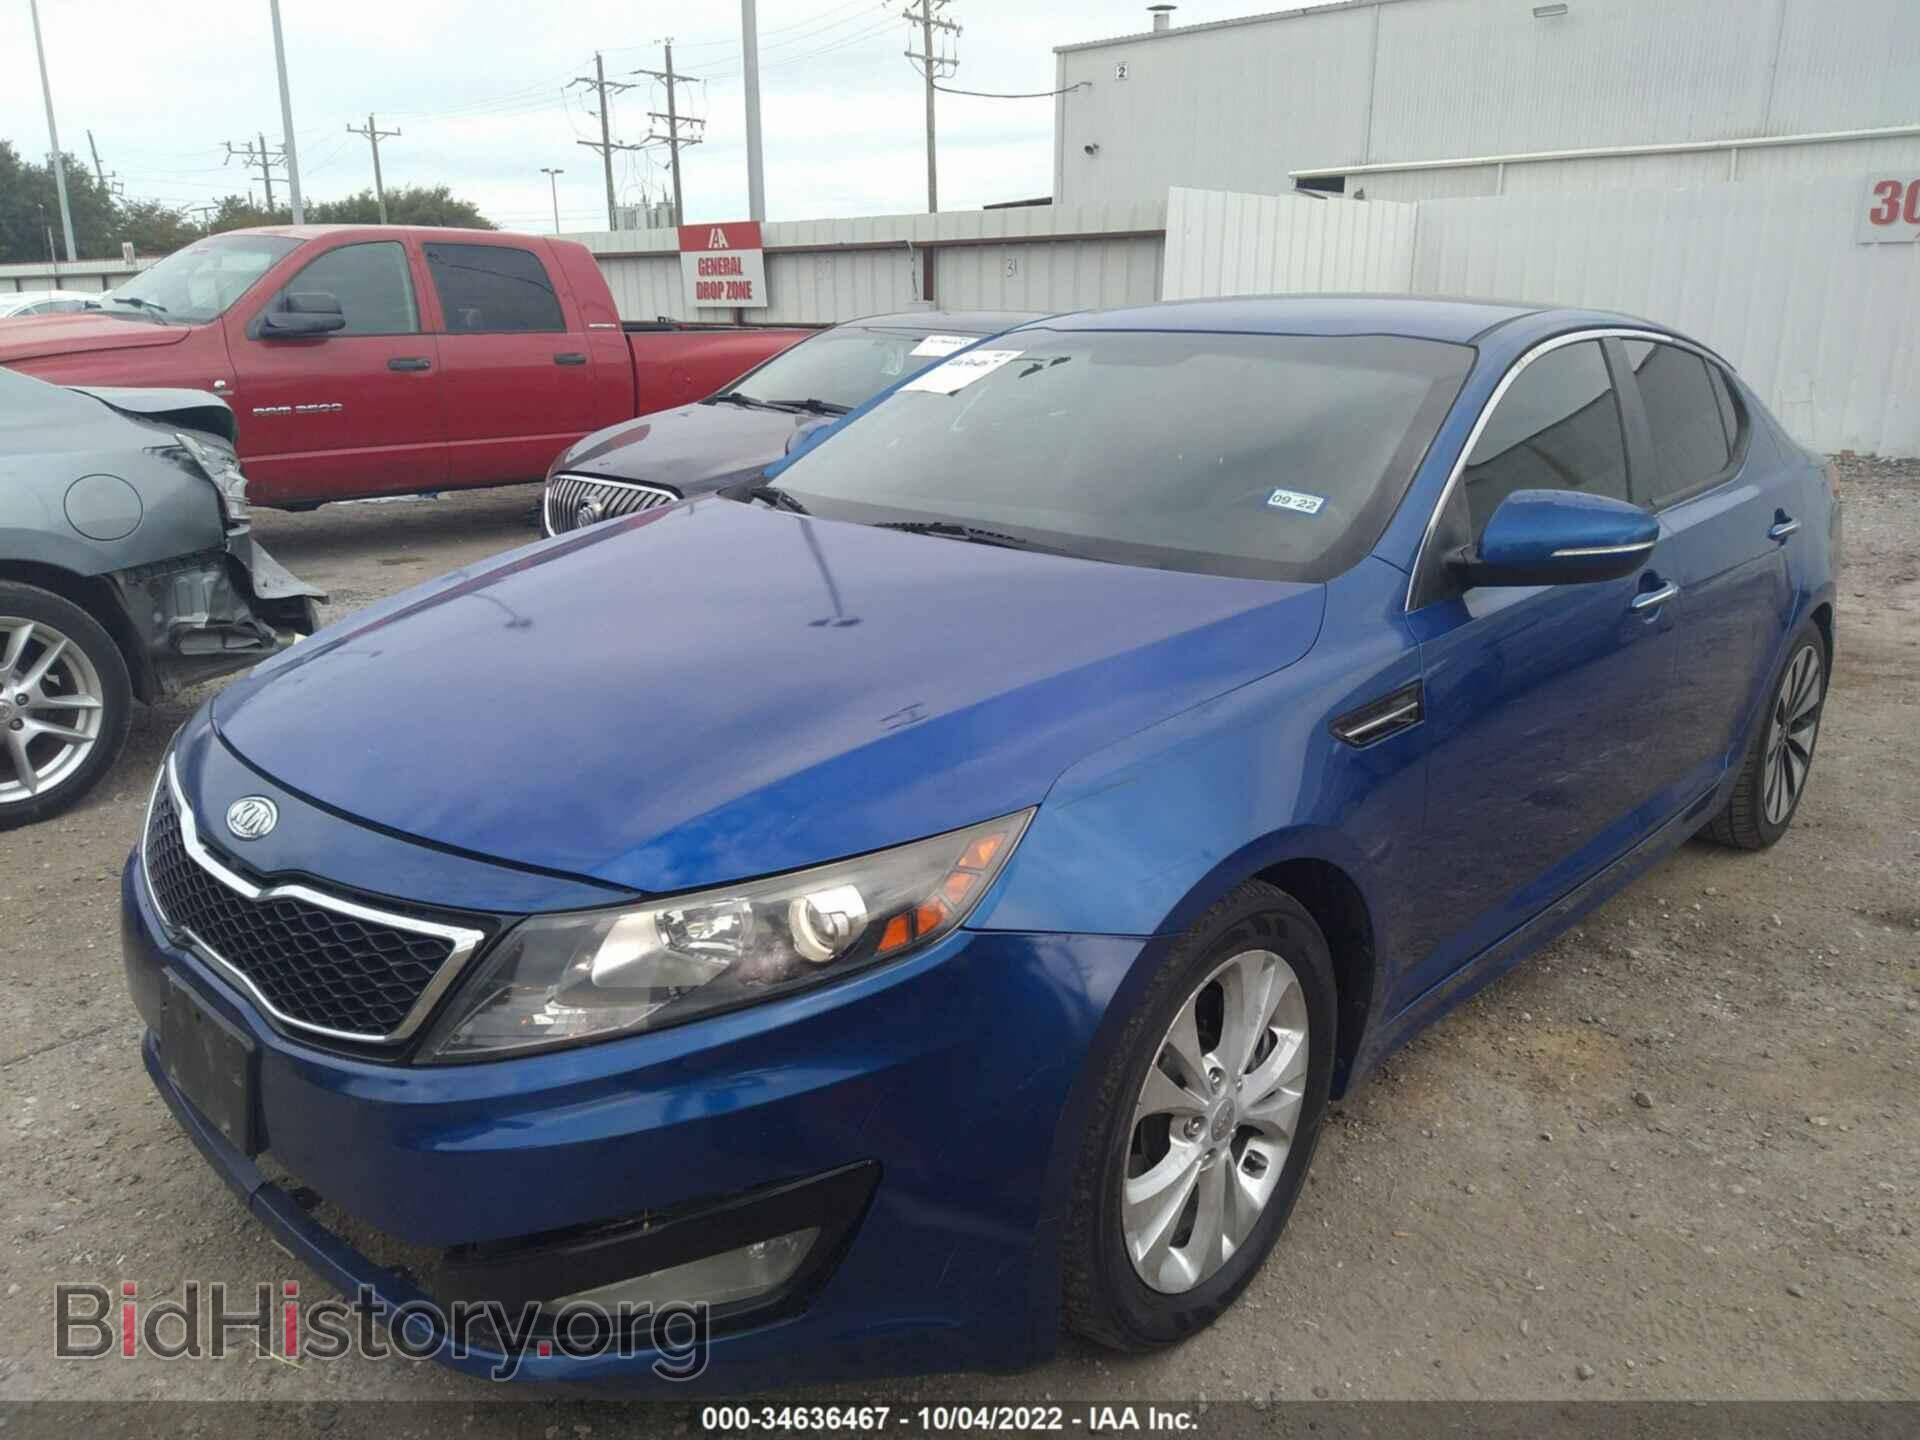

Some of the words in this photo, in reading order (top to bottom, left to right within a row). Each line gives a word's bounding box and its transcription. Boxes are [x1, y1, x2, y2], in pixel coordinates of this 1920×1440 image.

[1118, 66, 1126, 78] 2
[697, 256, 744, 277] GENERAL
[695, 281, 725, 301] DROP
[726, 280, 753, 300] ZONE
